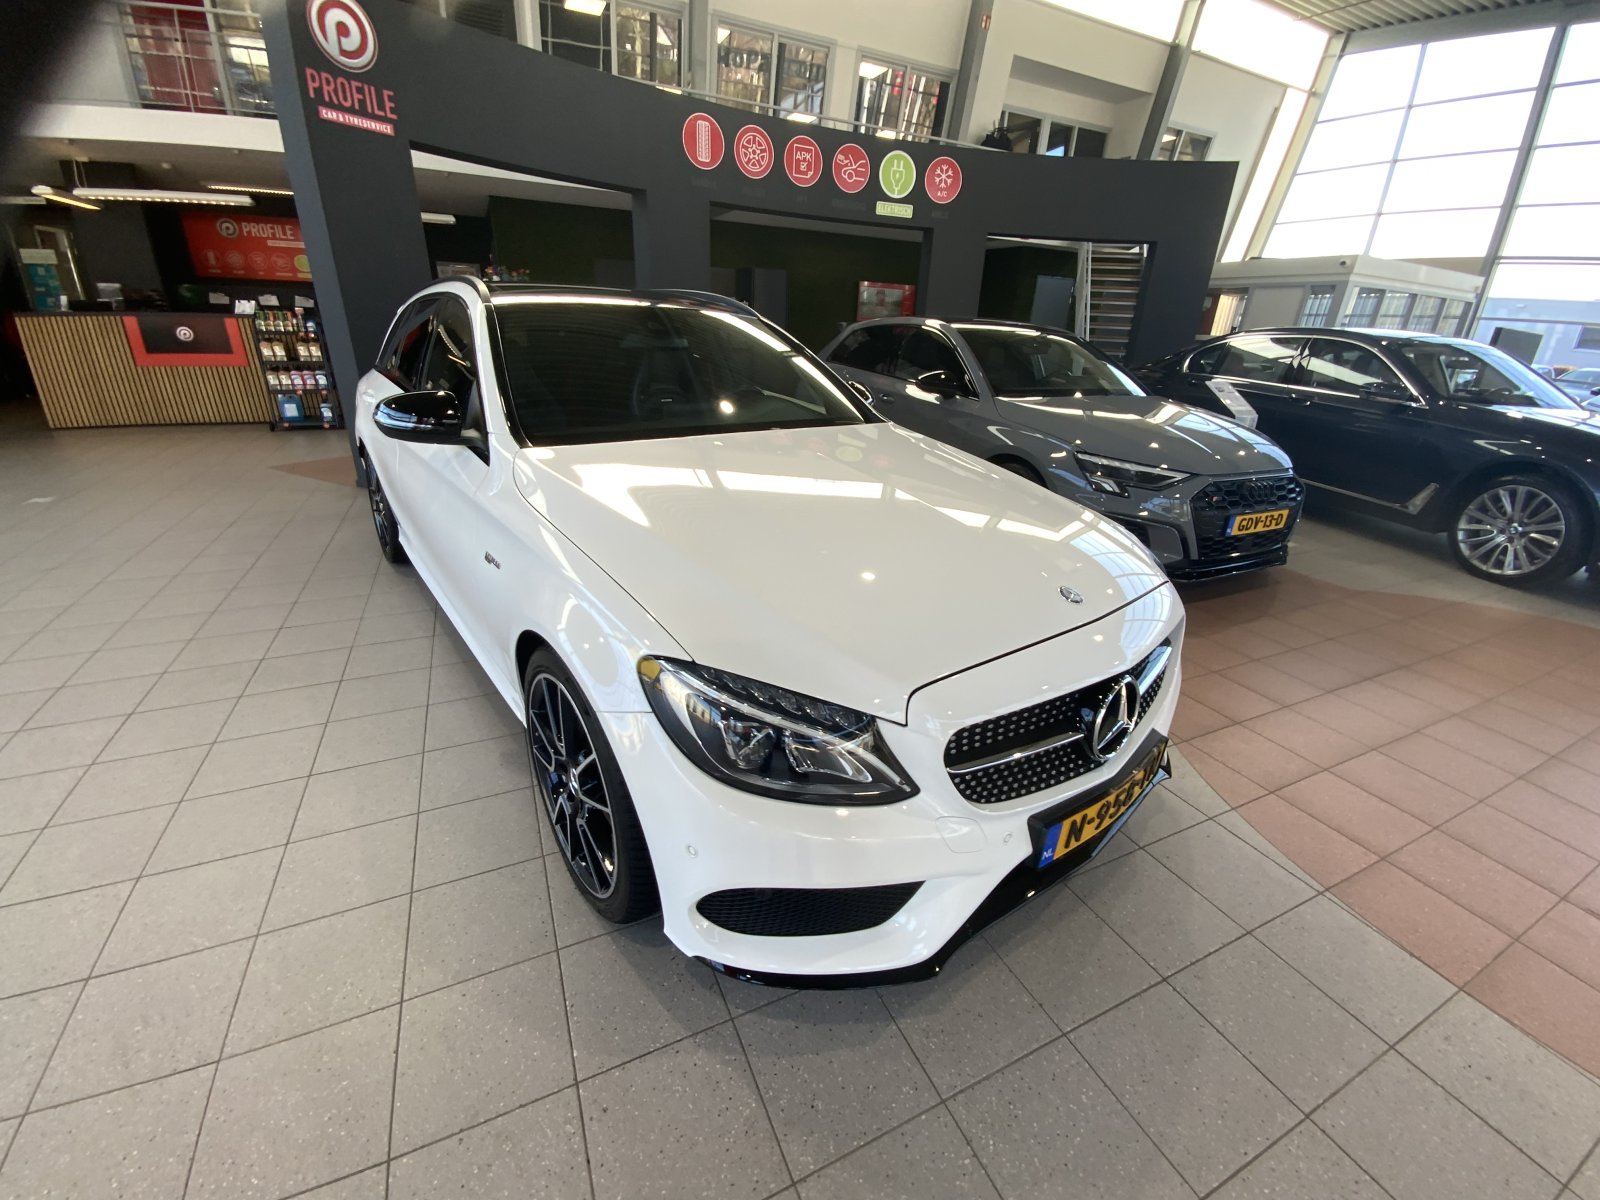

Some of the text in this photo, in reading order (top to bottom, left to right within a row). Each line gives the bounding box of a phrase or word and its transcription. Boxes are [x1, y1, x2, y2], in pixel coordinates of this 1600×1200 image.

[305, 67, 398, 120] PROFILE
[795, 150, 812, 162] APK
[936, 189, 948, 198] A/C
[241, 222, 295, 240] PROFILE
[1237, 513, 1284, 532] GDV-13-D
[1042, 848, 1054, 860] NL
